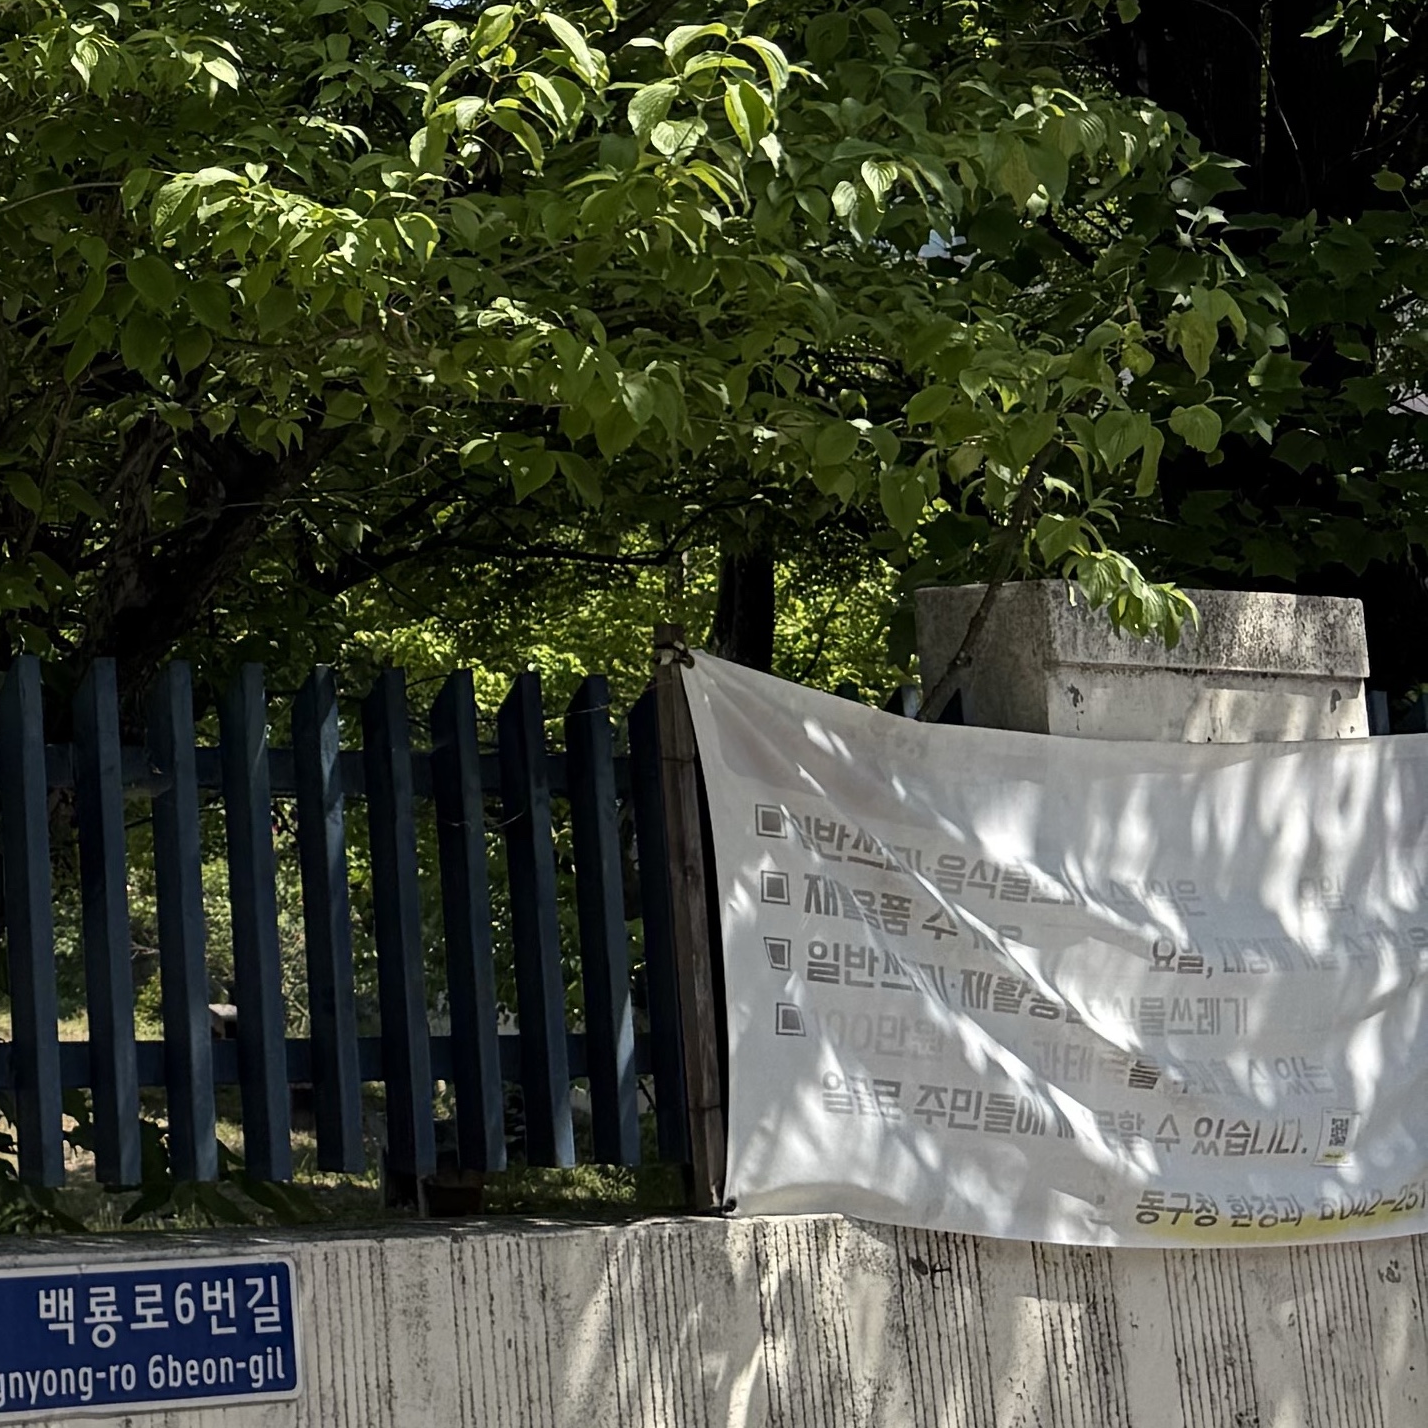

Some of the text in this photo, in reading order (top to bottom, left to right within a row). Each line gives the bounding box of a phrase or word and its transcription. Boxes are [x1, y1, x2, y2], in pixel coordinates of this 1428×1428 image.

[1154, 1113, 1181, 1153] 수
[1191, 1115, 1308, 1158] 있습니다.
[1135, 1189, 1220, 1227] 동구청
[1226, 1192, 1306, 1229] 환경과
[38, 1275, 283, 1349] 백룡로6번길
[148, 1346, 286, 1390] 6beon-gil
